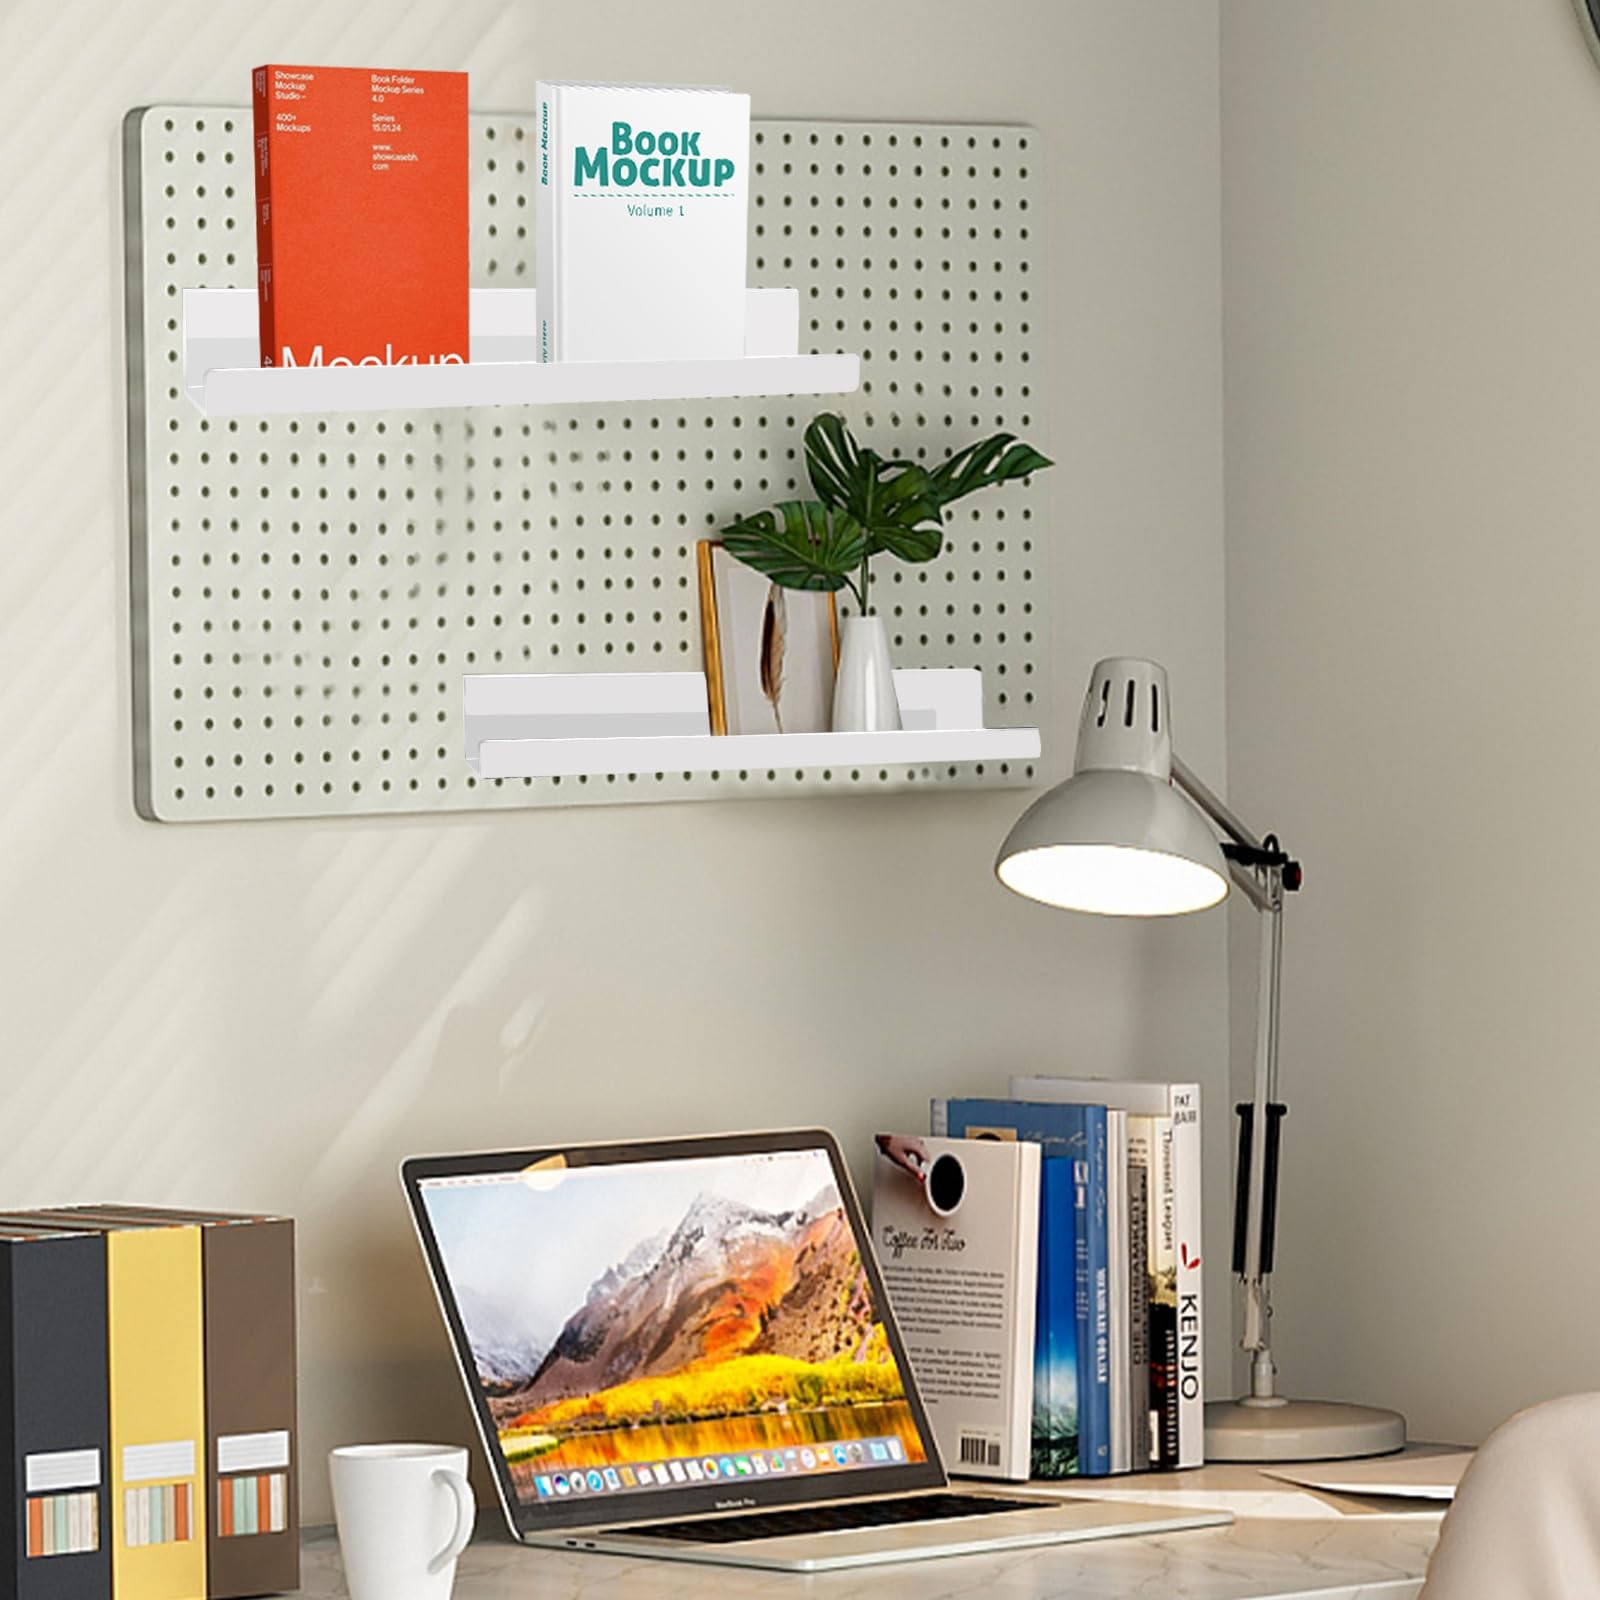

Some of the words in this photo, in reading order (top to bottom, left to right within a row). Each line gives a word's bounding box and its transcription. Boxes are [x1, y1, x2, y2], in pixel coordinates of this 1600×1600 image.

[275, 71, 314, 81] Showcase
[371, 74, 390, 84] Book
[391, 75, 415, 84] Folder
[275, 81, 306, 91] Mockup
[371, 84, 401, 95] Mockup
[401, 85, 425, 94] Series
[275, 90, 300, 100] Studio
[372, 94, 385, 103] 4.0
[372, 112, 395, 122] Series
[276, 123, 312, 133] Mockups
[372, 163, 389, 171] com
[627, 204, 674, 217] Volume
[678, 205, 685, 217] 1
[1162, 1130, 1173, 1194] Thousand
[1162, 1197, 1173, 1250] Leagues
[882, 1225, 919, 1258] Coffee
[1181, 1294, 1199, 1400] KENJO
